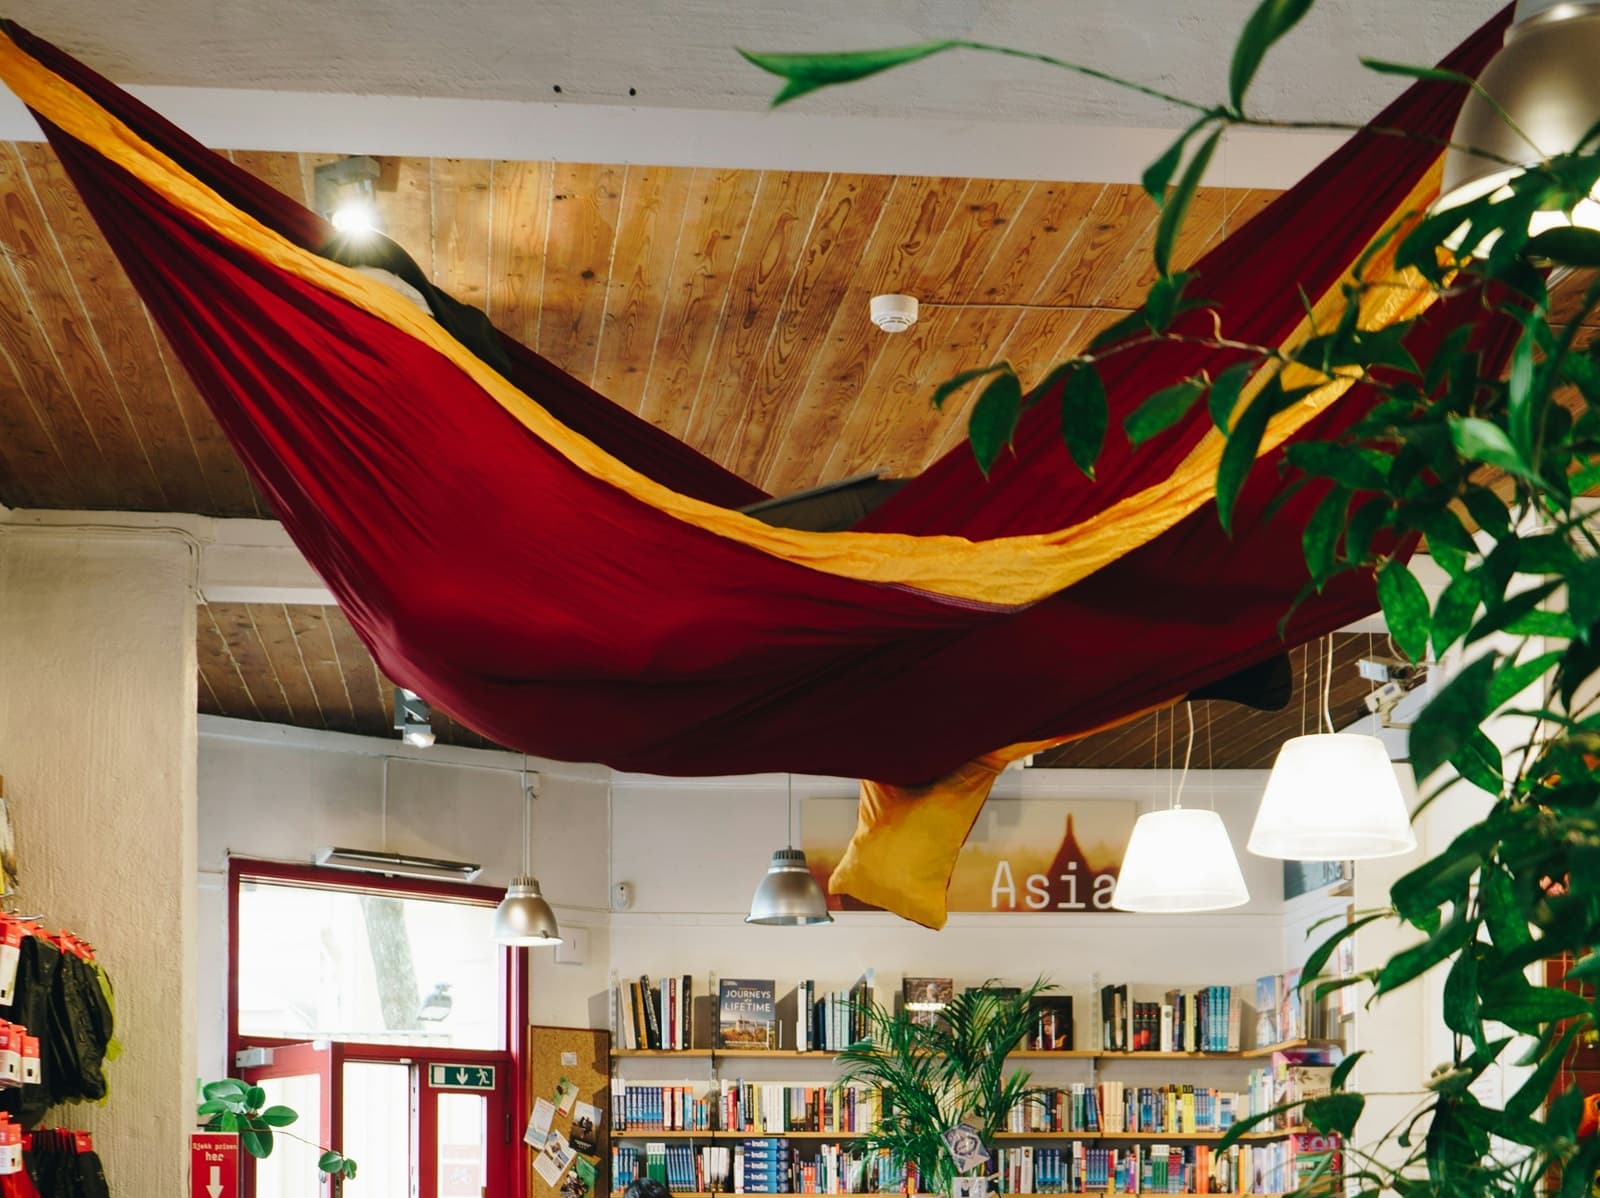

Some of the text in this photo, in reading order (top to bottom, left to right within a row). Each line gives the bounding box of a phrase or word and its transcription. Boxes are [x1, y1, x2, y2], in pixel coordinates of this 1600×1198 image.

[991, 860, 1116, 910] Asia
[726, 990, 771, 999] JOURNEYS
[725, 1002, 771, 1012] LIFETIME
[205, 1151, 224, 1161] her
